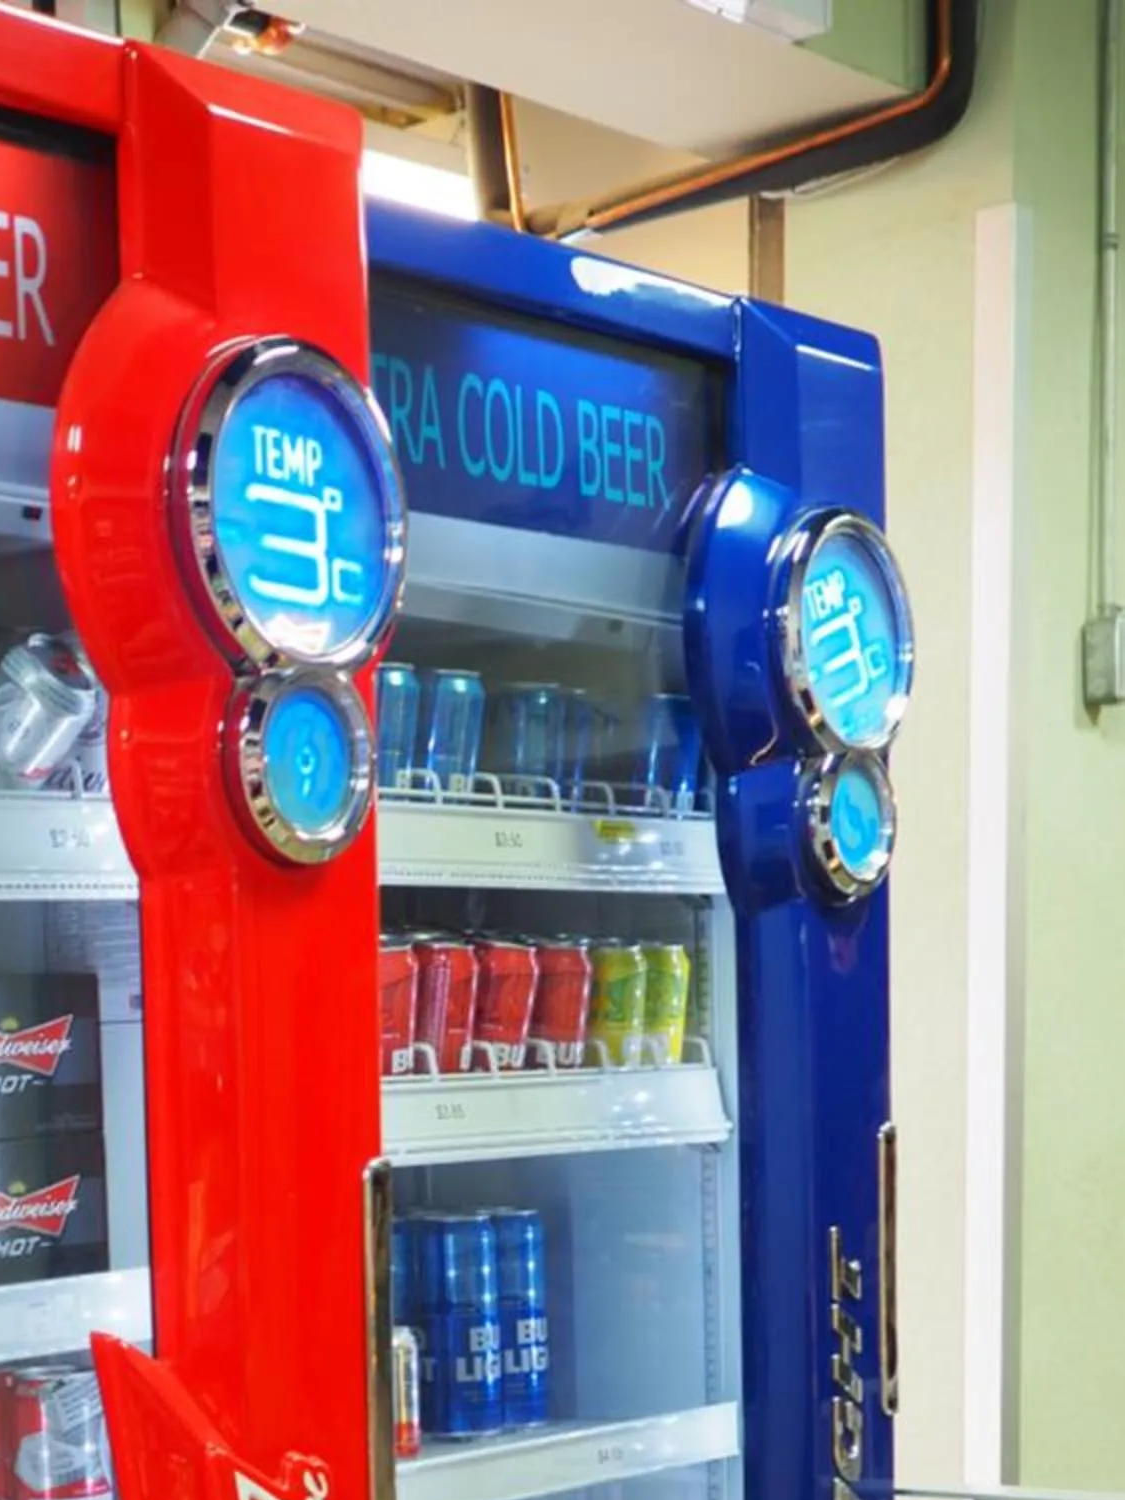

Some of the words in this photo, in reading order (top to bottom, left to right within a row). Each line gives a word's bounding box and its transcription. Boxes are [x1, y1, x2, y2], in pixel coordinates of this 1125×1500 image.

[252, 426, 323, 487] TEMP
[457, 372, 565, 490] COLD
[578, 400, 671, 511] BEER
[805, 570, 846, 621] TEMP
[456, 1355, 502, 1383] LIG
[504, 1347, 550, 1374] LIG
